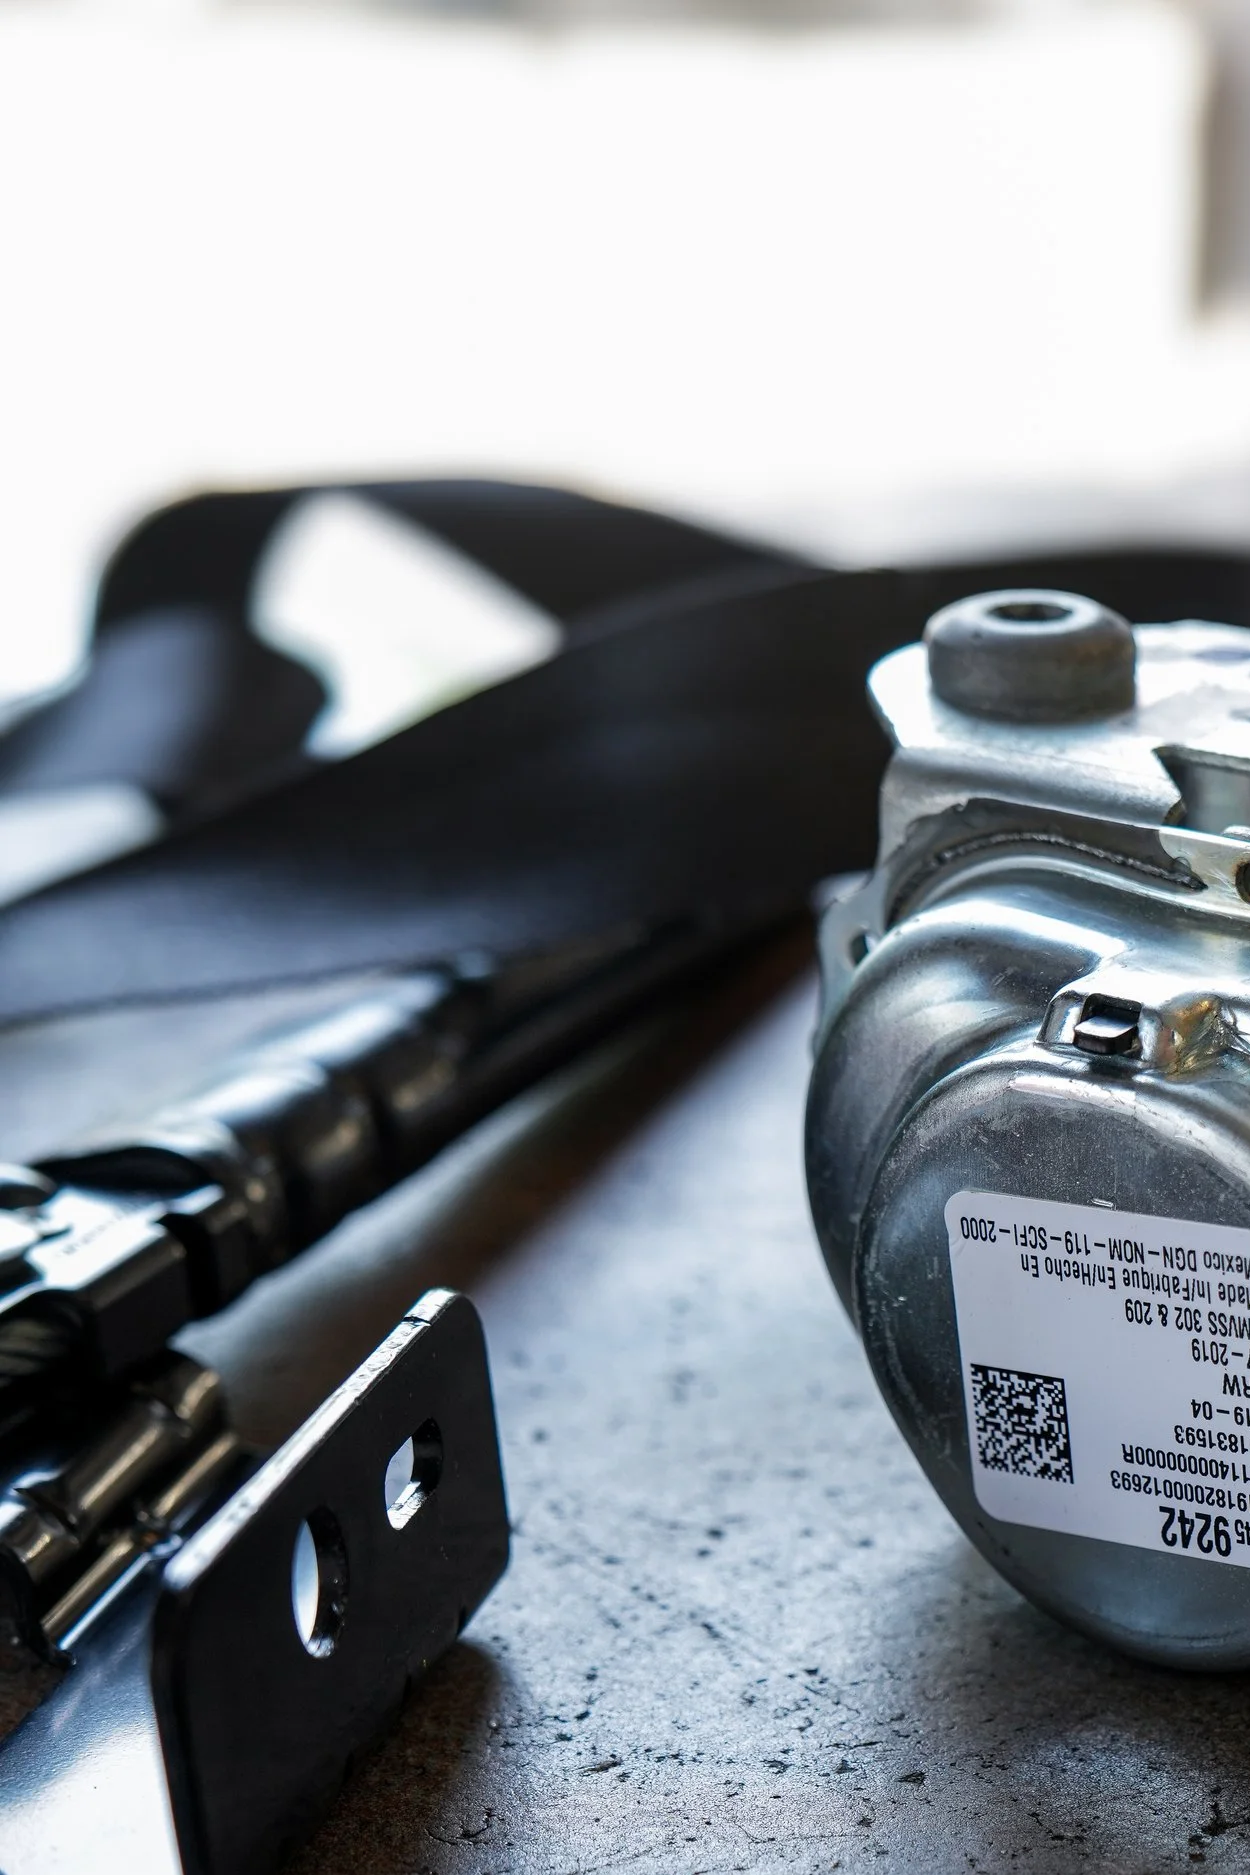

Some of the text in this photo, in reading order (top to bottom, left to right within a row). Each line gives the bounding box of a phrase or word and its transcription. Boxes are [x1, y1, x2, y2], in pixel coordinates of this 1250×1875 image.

[1021, 1254, 1038, 1278] En
[1045, 1257, 1115, 1289] En/Hecho
[1123, 1267, 1211, 1304] In/Fabrique
[1125, 1299, 1152, 1322] 209
[1157, 1304, 1168, 1326] &
[1175, 1307, 1202, 1332] 302
